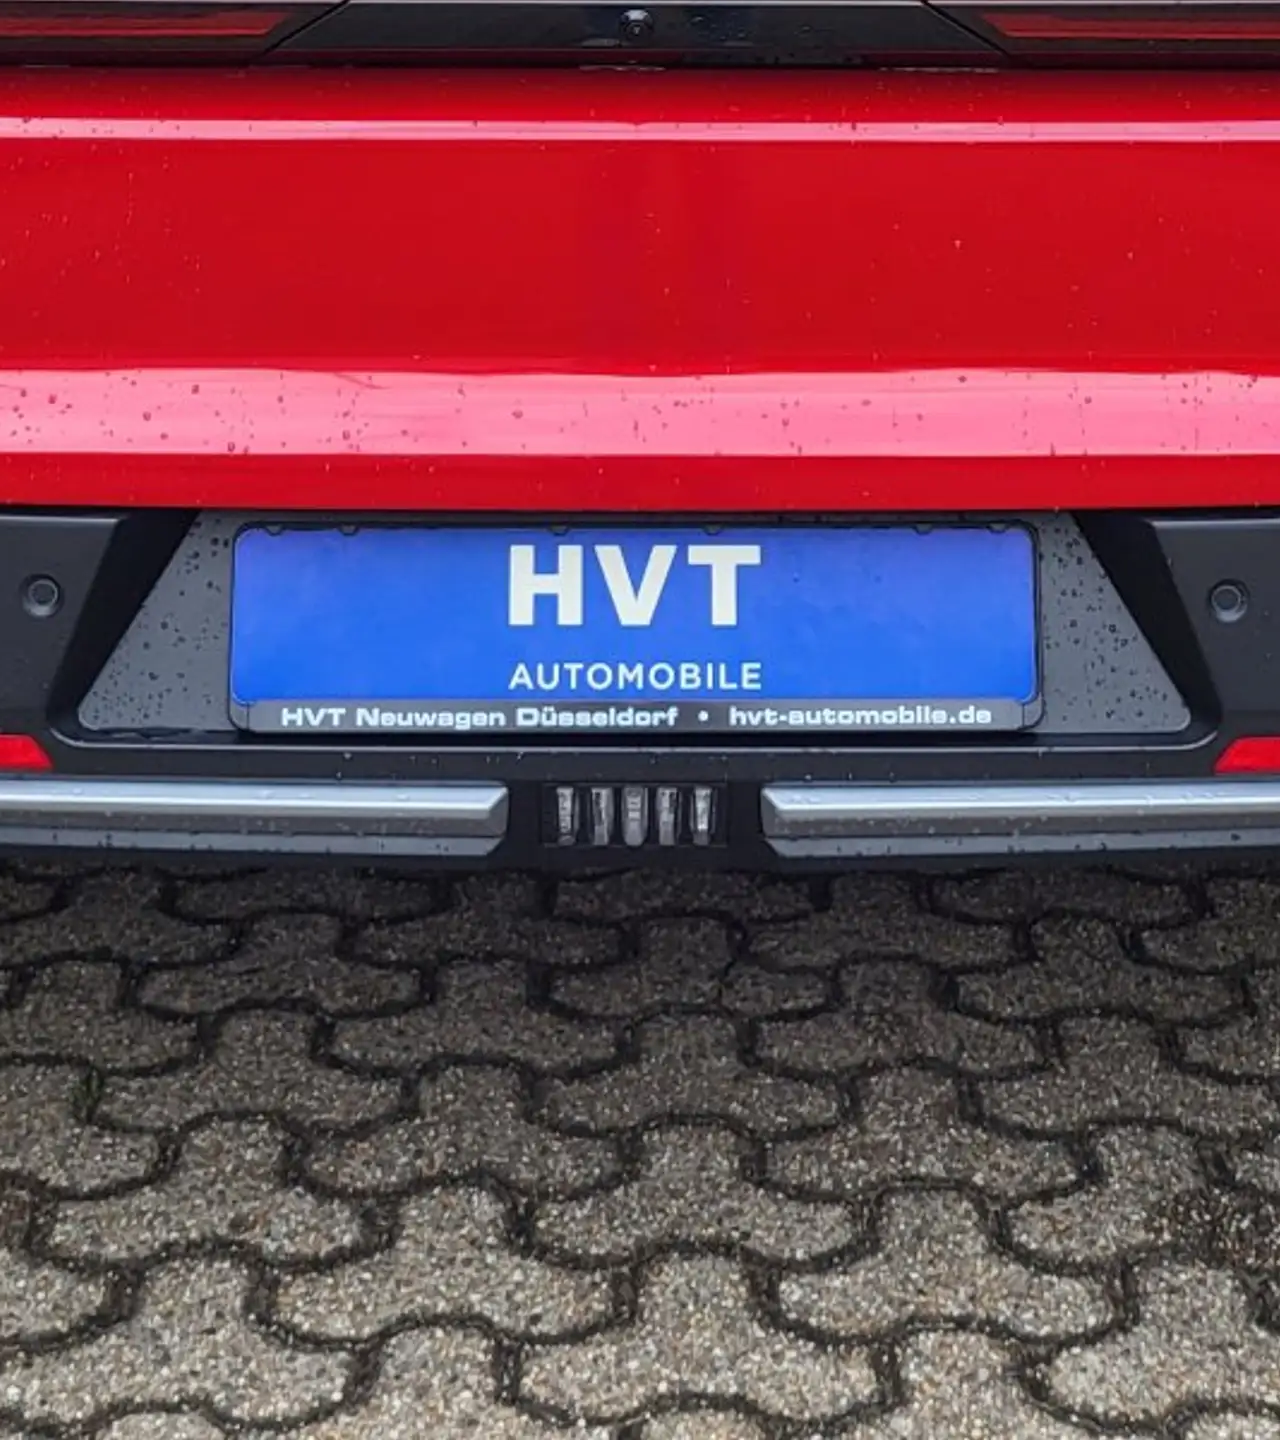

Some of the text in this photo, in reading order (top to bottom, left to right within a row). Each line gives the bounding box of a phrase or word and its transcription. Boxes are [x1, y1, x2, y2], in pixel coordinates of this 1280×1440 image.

[508, 544, 762, 627] HVT
[508, 662, 763, 691] AUTOMOBILE
[281, 705, 993, 730] HVT Neuwagen Düsseldorf hvt-automobile.de
